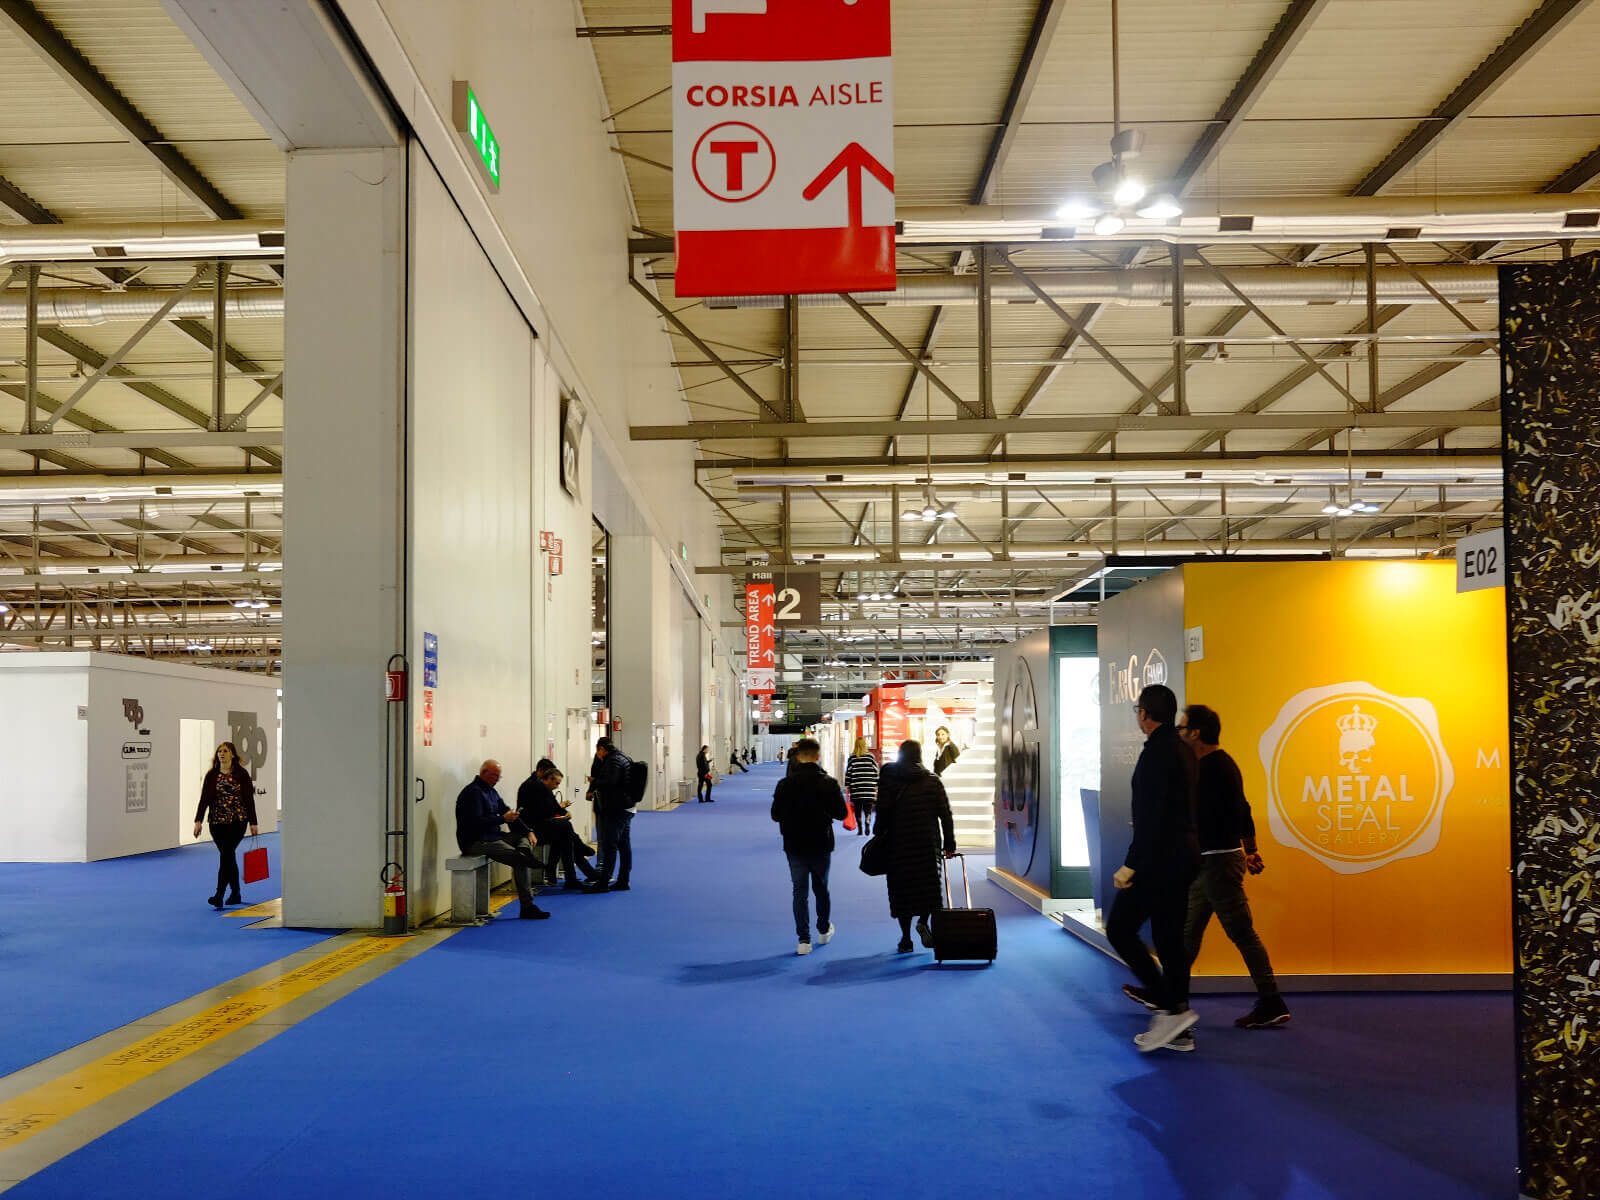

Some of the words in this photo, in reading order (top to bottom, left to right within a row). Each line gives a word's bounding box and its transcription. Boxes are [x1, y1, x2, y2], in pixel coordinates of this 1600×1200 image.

[686, 85, 799, 107] CORSIA
[808, 81, 883, 107] AISLE
[709, 141, 758, 191] T
[1464, 546, 1497, 578] E02
[748, 589, 760, 622] AREA
[748, 624, 760, 666] TREND
[1302, 775, 1415, 802] METAL
[1316, 803, 1401, 832] SEAL
[1317, 832, 1401, 846] GALLERY
